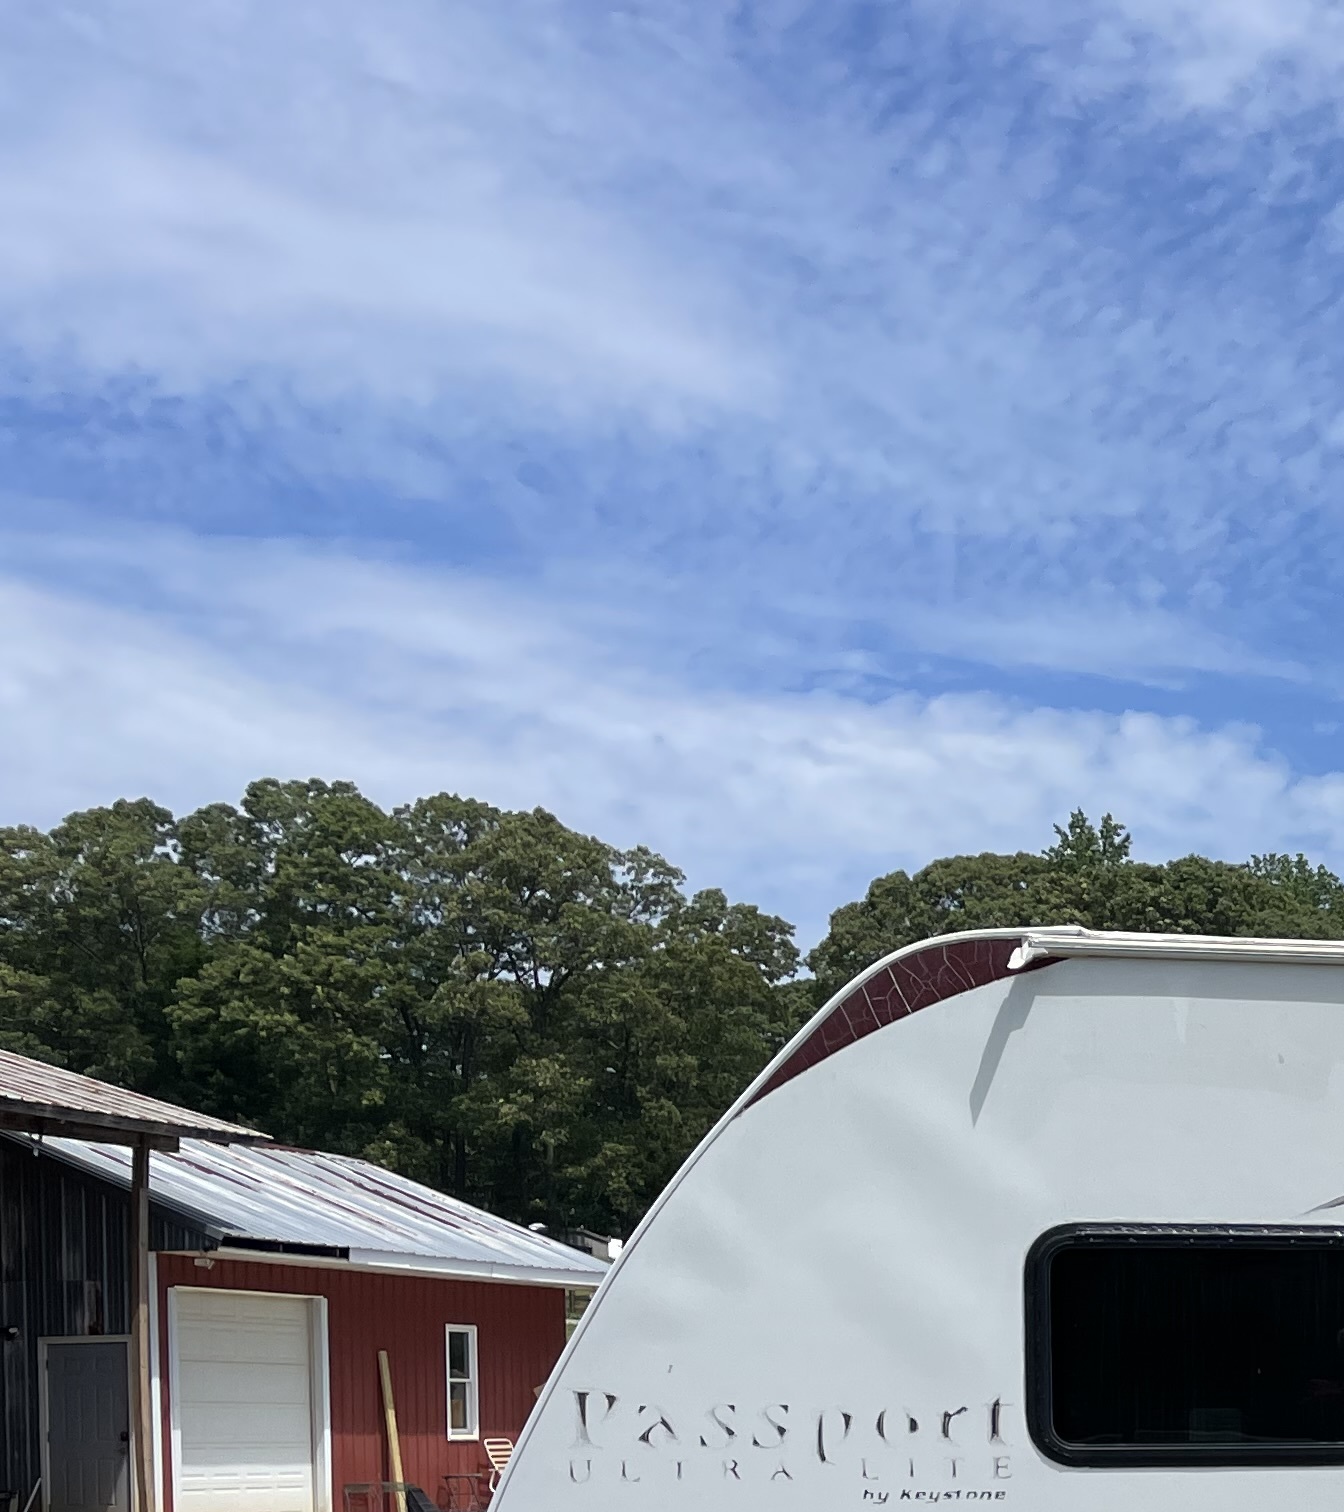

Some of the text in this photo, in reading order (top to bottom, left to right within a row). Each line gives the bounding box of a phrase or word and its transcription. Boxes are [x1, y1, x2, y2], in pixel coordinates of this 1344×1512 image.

[568, 1387, 1014, 1464] Passport
[569, 1456, 1013, 1484] ULTRA LITE
[862, 1488, 1007, 1505] by Keystone
